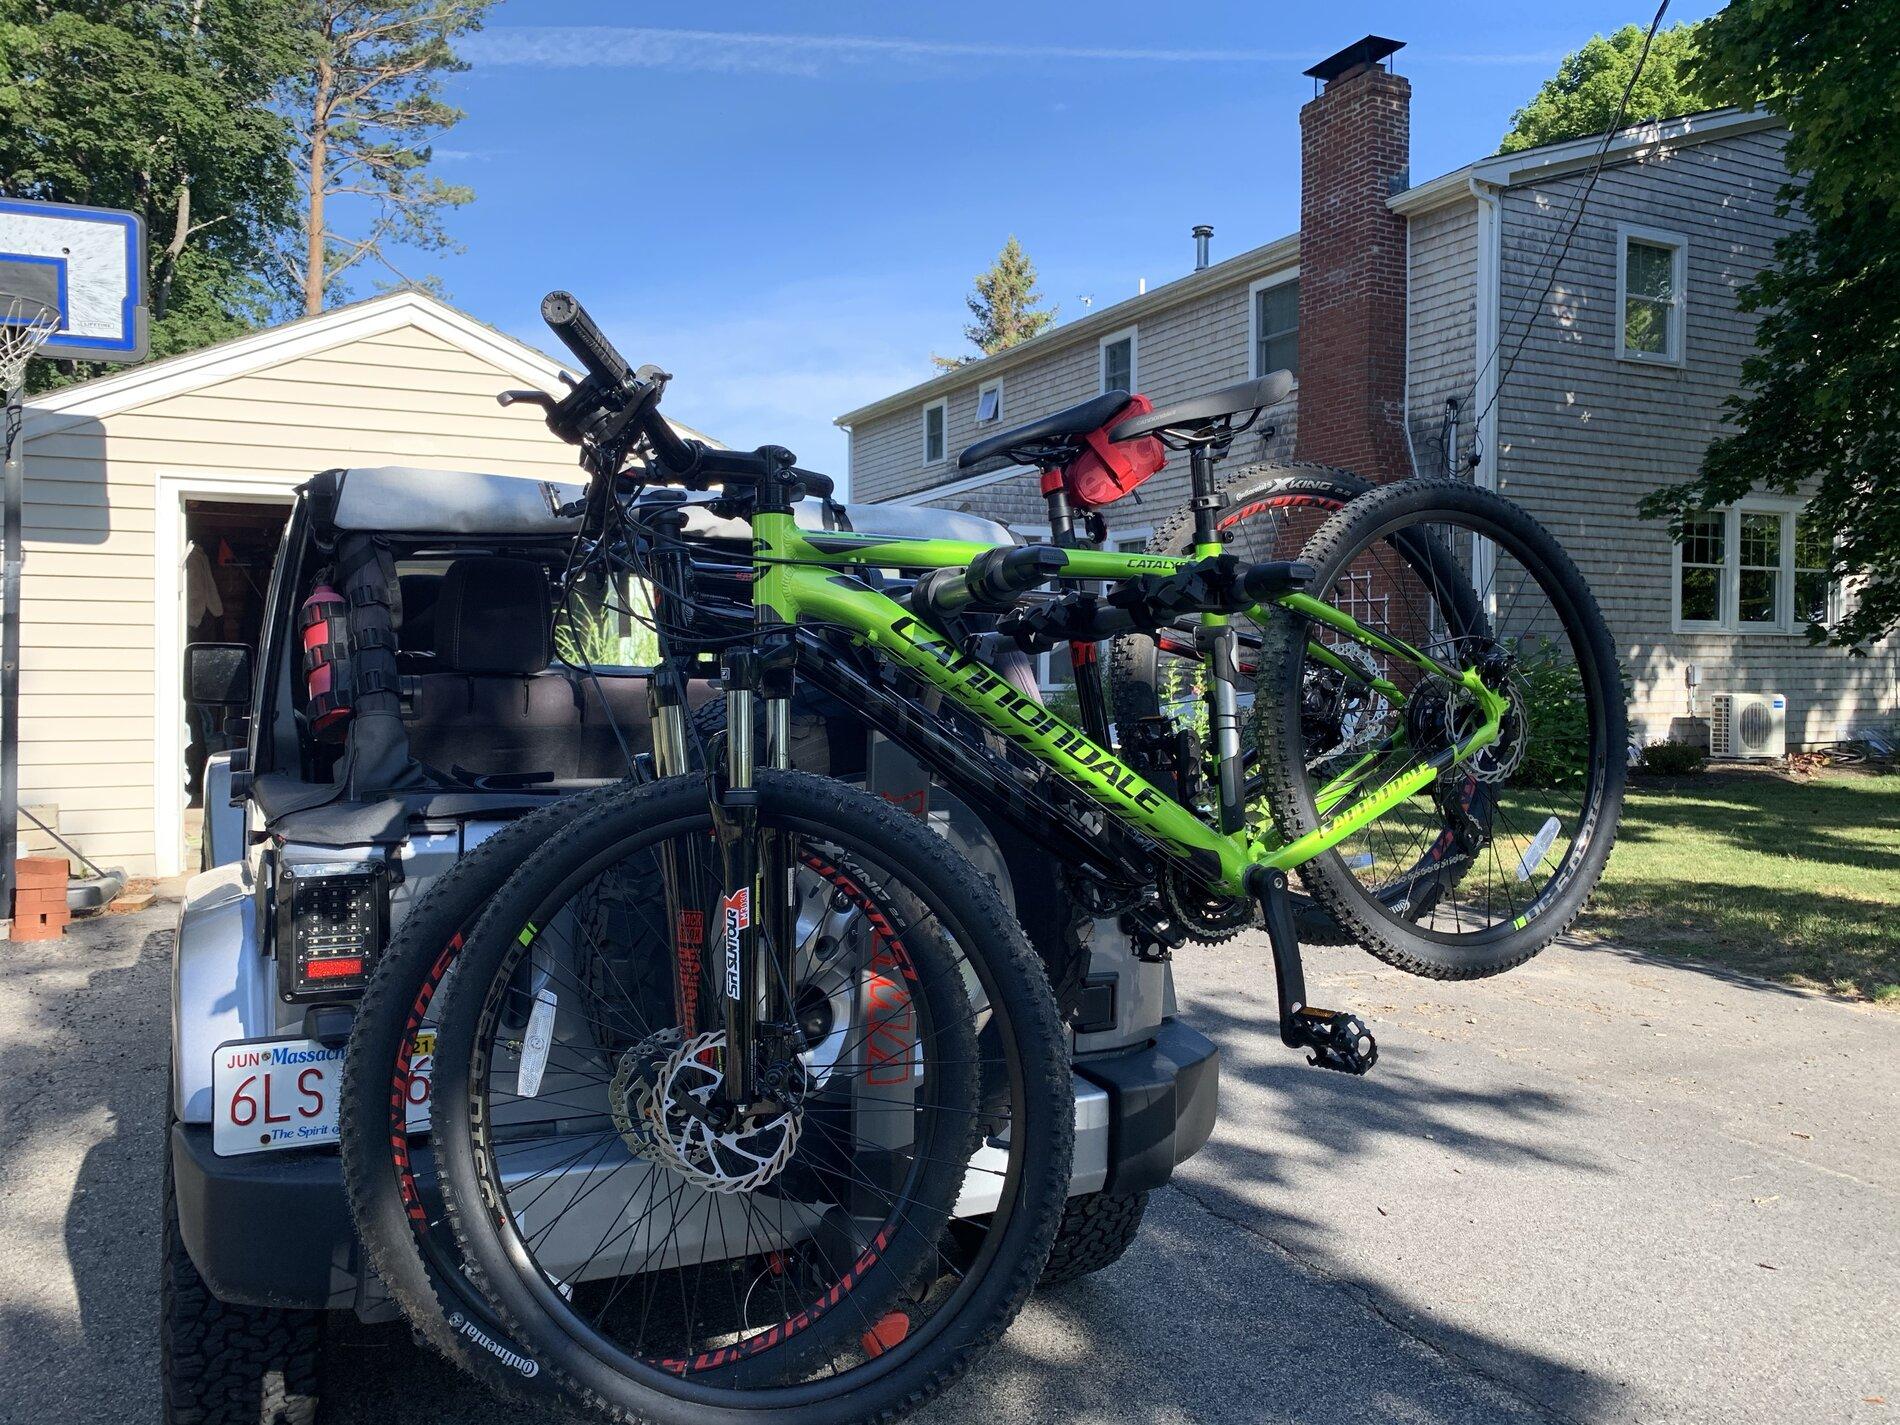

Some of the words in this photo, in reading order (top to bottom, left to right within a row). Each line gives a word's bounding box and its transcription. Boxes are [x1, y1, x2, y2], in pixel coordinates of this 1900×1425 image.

[726, 908, 738, 970] SUNTOUR
[227, 1053, 260, 1069] JUN
[272, 1129, 294, 1140] The
[297, 1125, 328, 1139] Spirit
[460, 1320, 540, 1378] Continental
